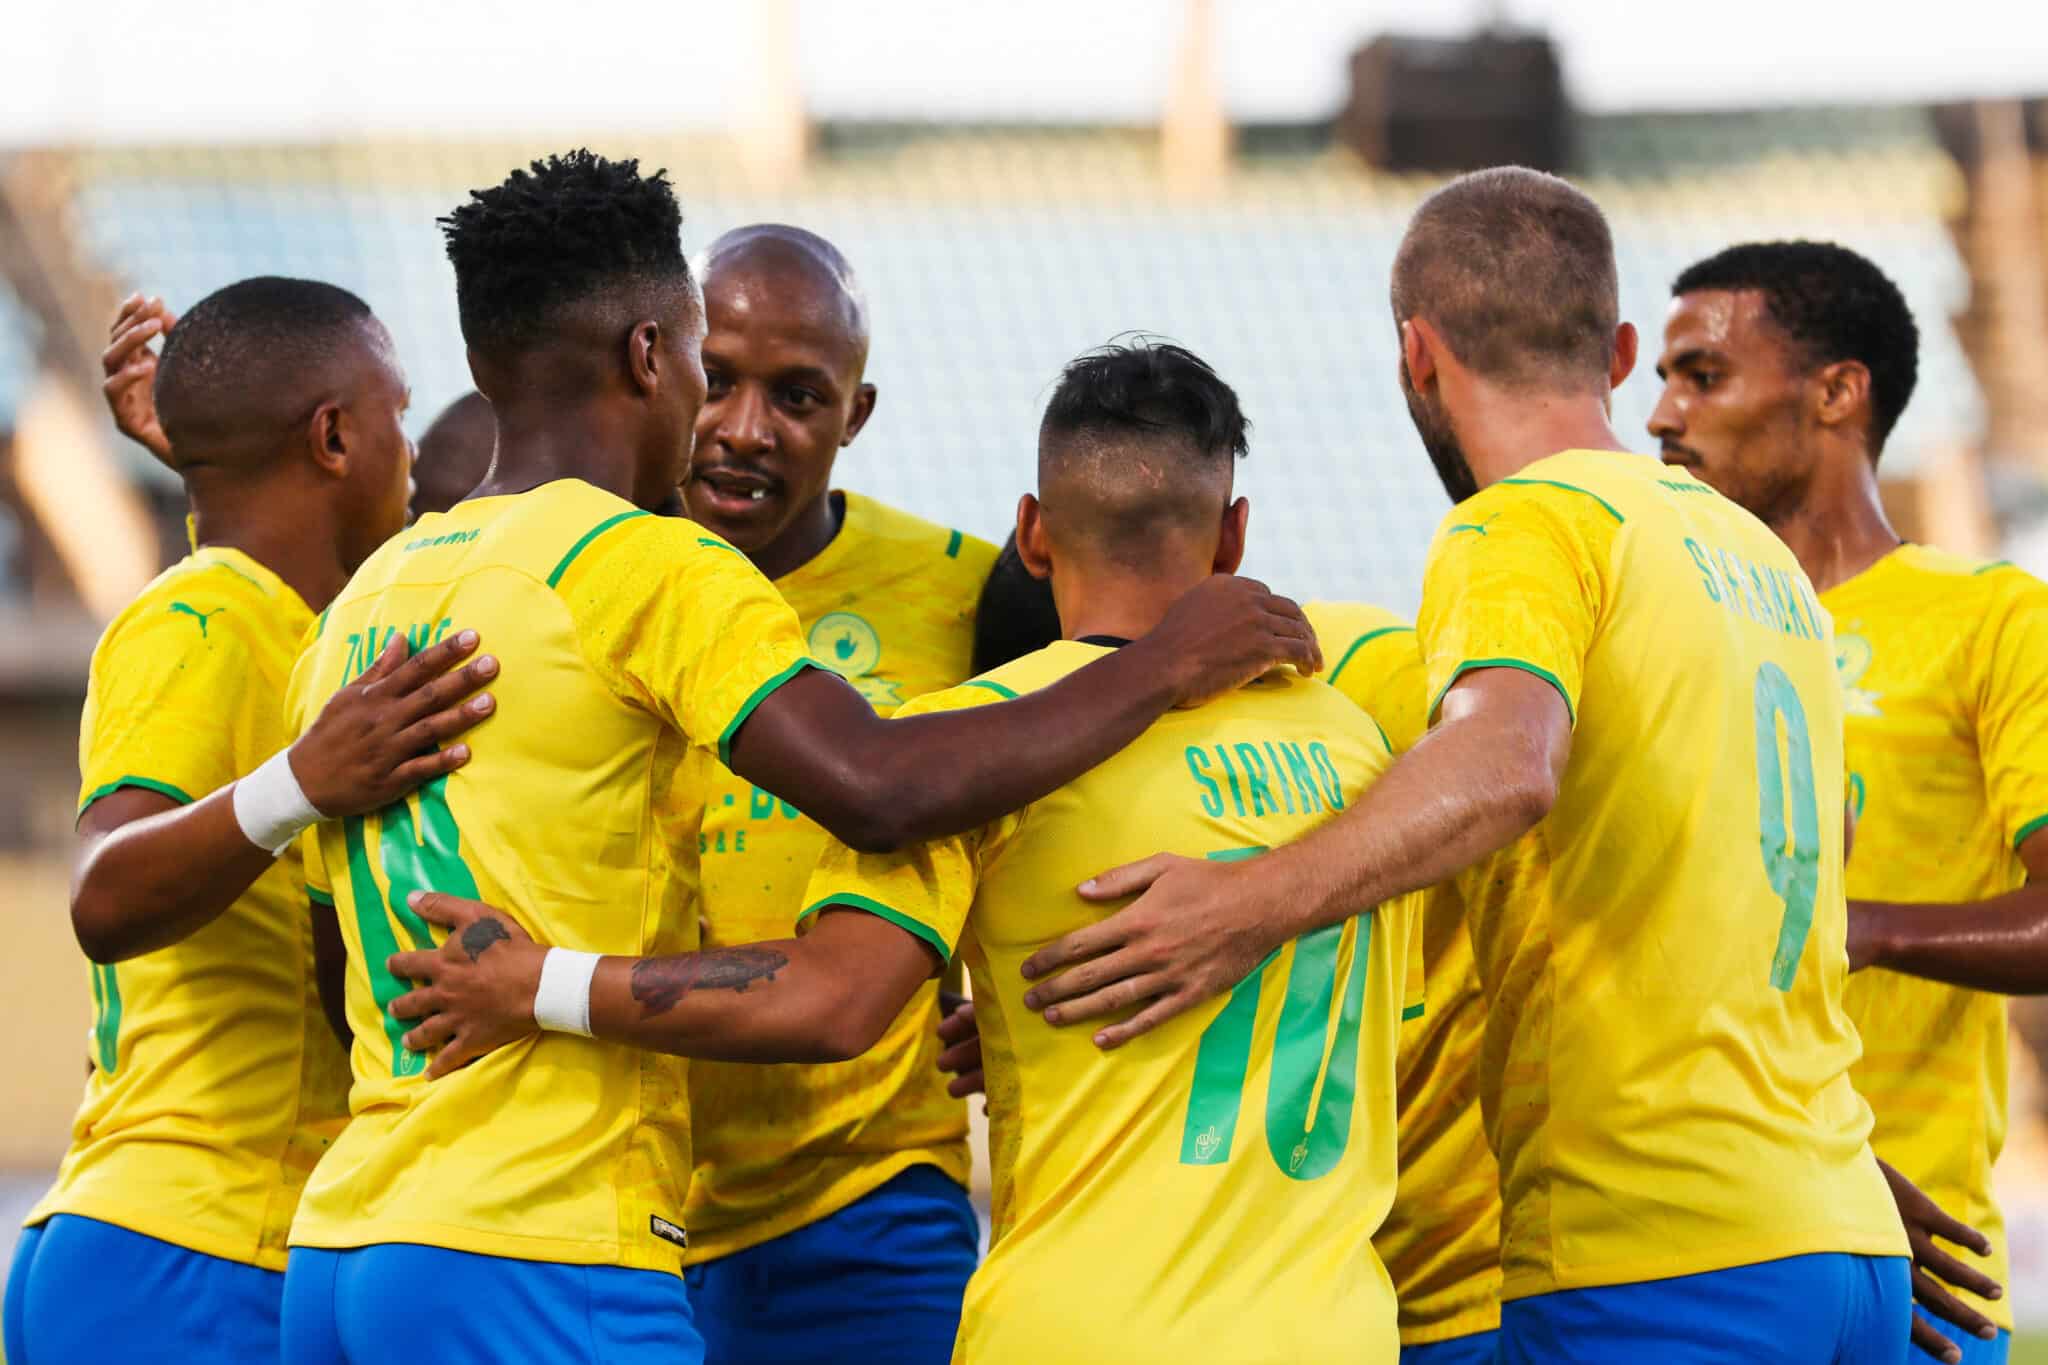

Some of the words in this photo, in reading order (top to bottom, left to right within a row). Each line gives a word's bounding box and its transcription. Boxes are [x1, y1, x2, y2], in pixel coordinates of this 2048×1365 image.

[341, 617, 452, 688] ZWN
[1185, 741, 1345, 818] SIRINO
[1753, 661, 1820, 993] 9
